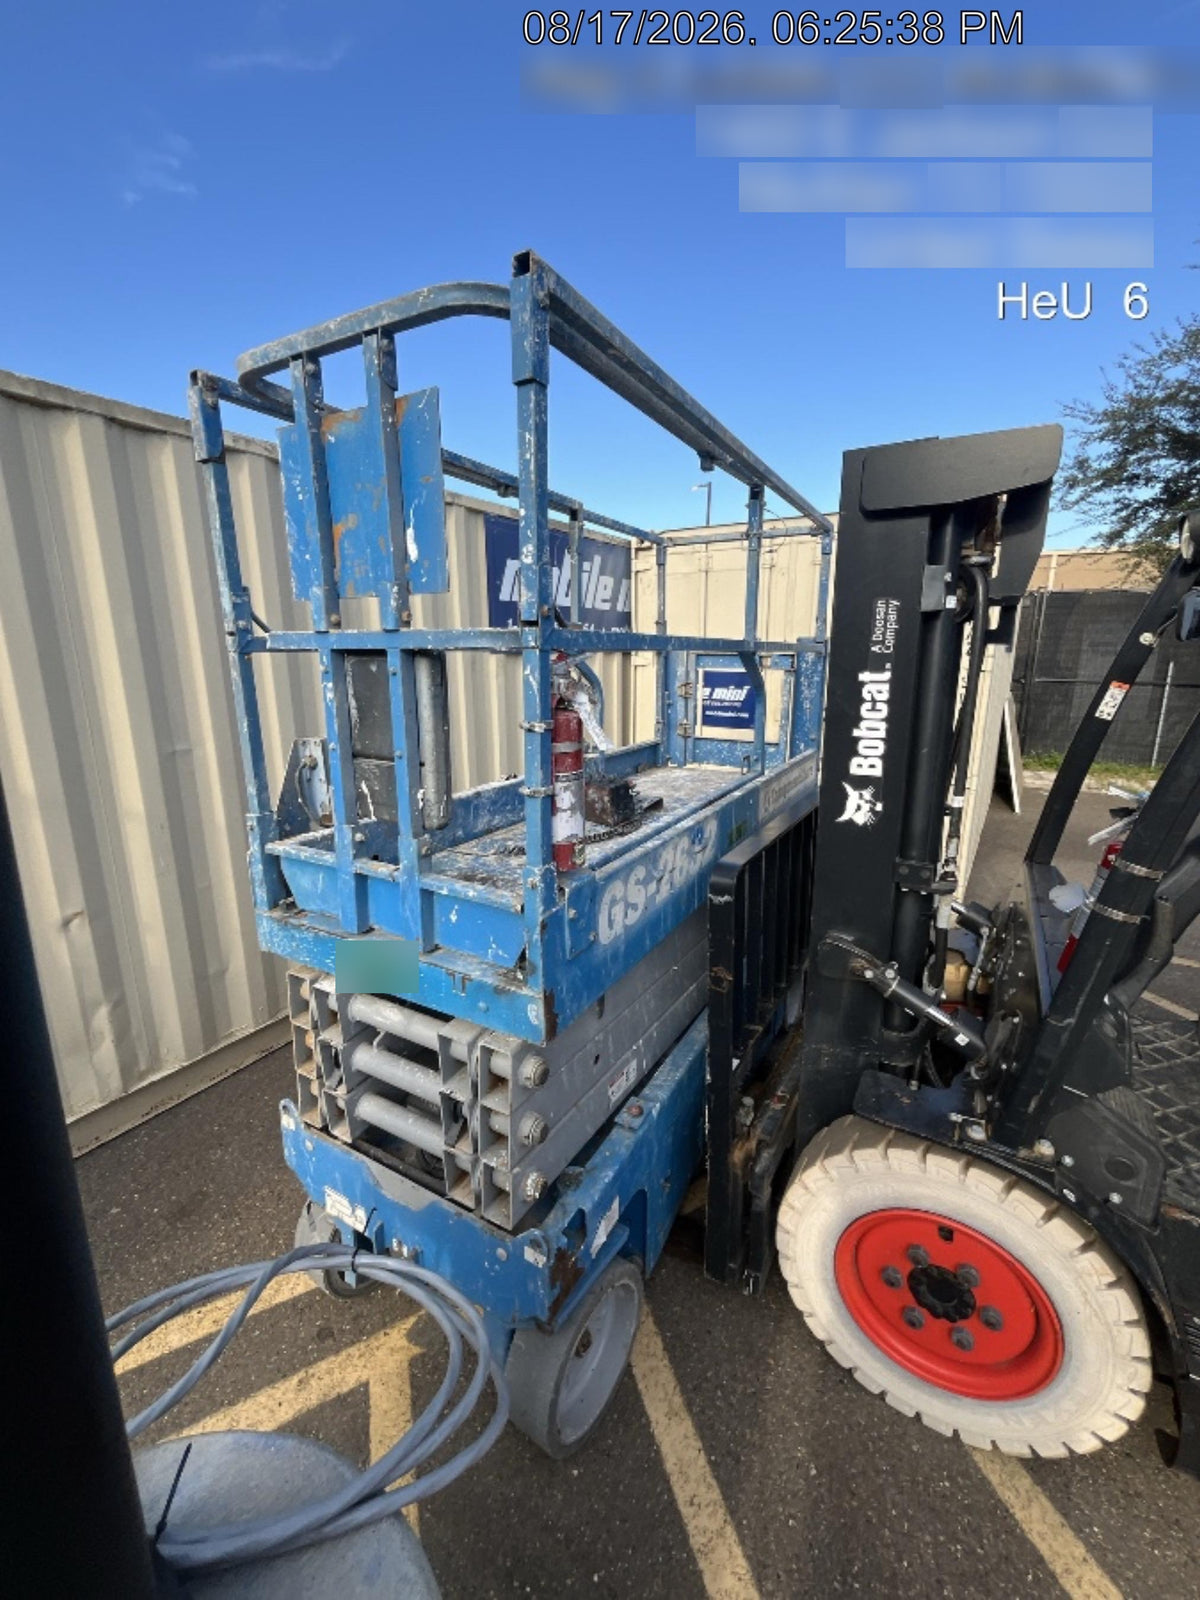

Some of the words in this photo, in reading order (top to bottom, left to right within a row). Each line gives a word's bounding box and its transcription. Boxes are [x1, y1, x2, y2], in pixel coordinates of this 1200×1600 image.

[872, 600, 886, 641] Doosan
[882, 599, 900, 653] Company
[871, 645, 882, 654] A
